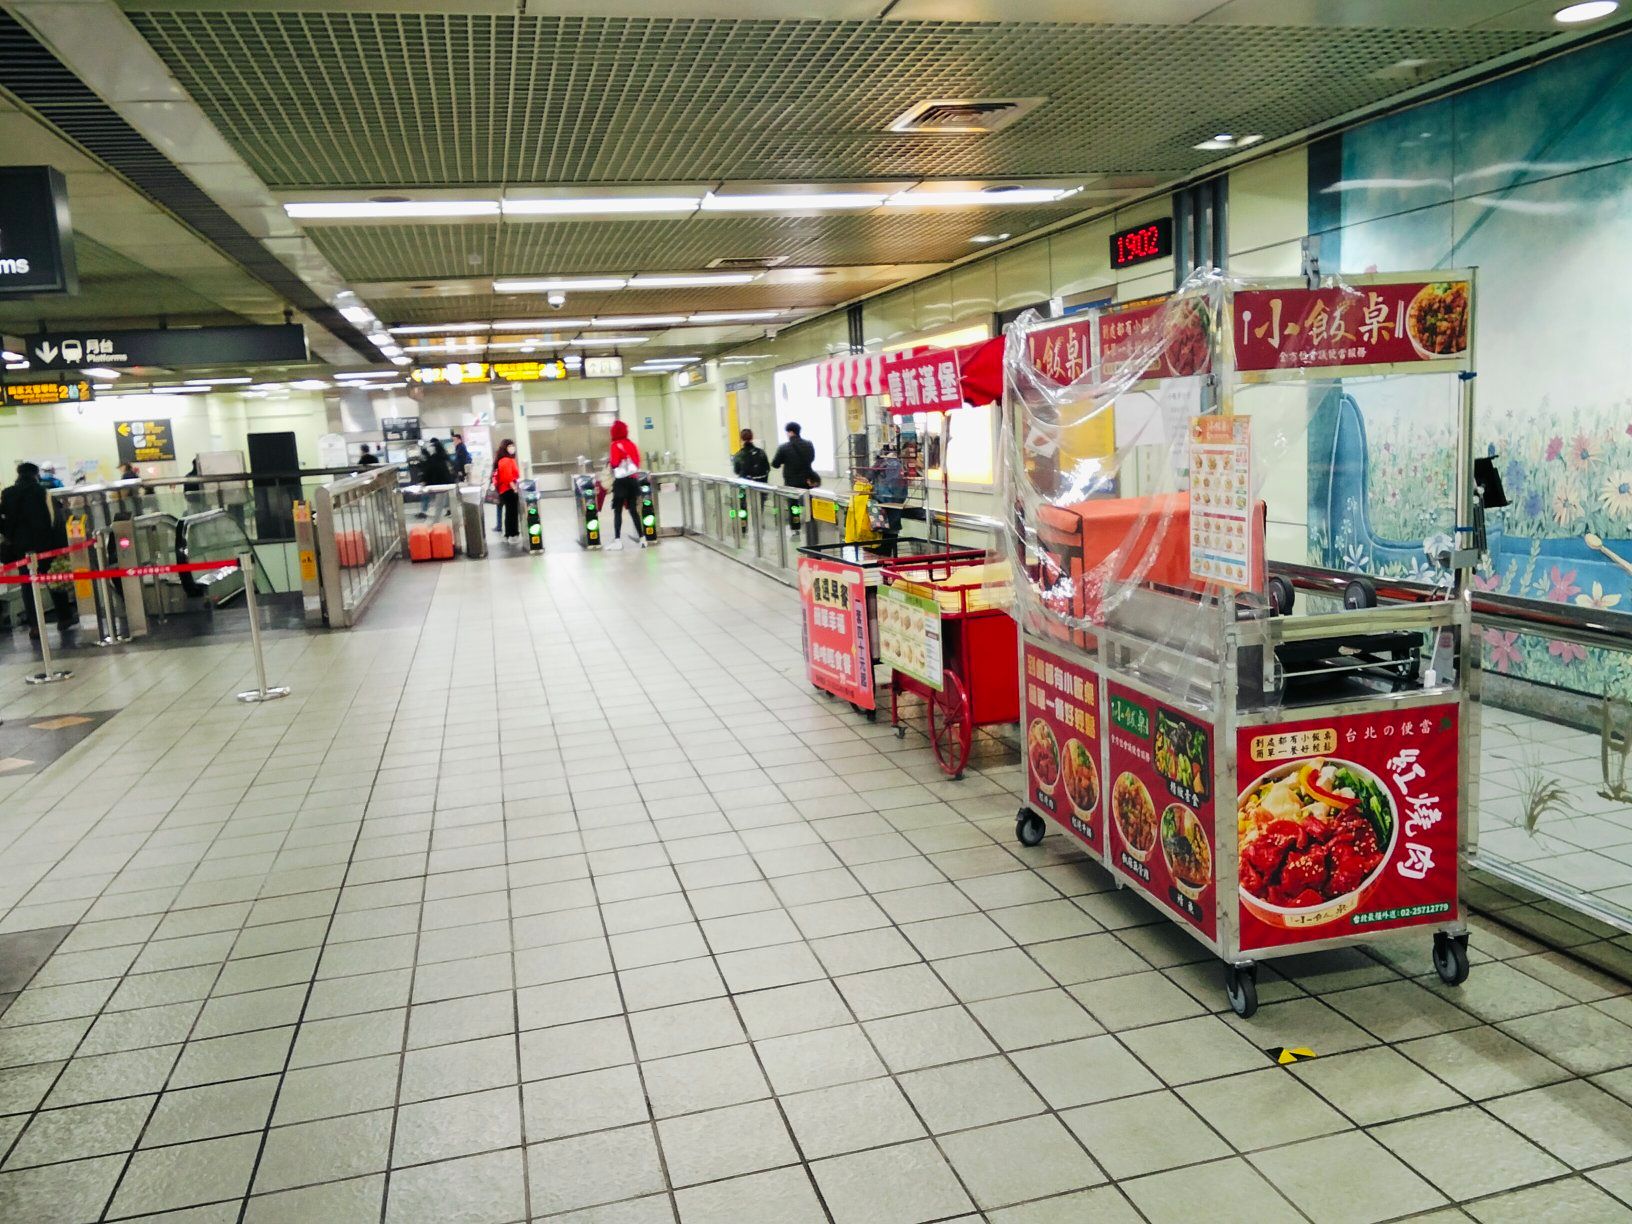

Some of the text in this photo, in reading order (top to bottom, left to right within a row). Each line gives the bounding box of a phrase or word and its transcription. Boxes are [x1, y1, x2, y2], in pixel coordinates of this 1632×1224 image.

[1254, 291, 1395, 349] 小飯桌
[887, 360, 959, 408] 摩斯漢堡
[1027, 653, 1095, 707] 到處都有小飯桌
[1028, 682, 1096, 739] 簡單一餐好輕鬆
[1345, 718, 1433, 743] 台北の便當
[1256, 730, 1332, 749] 到處都有小飯桌
[1256, 741, 1332, 759] 簡單一餐好輕鬆
[1386, 748, 1442, 880] 紅燒肉
